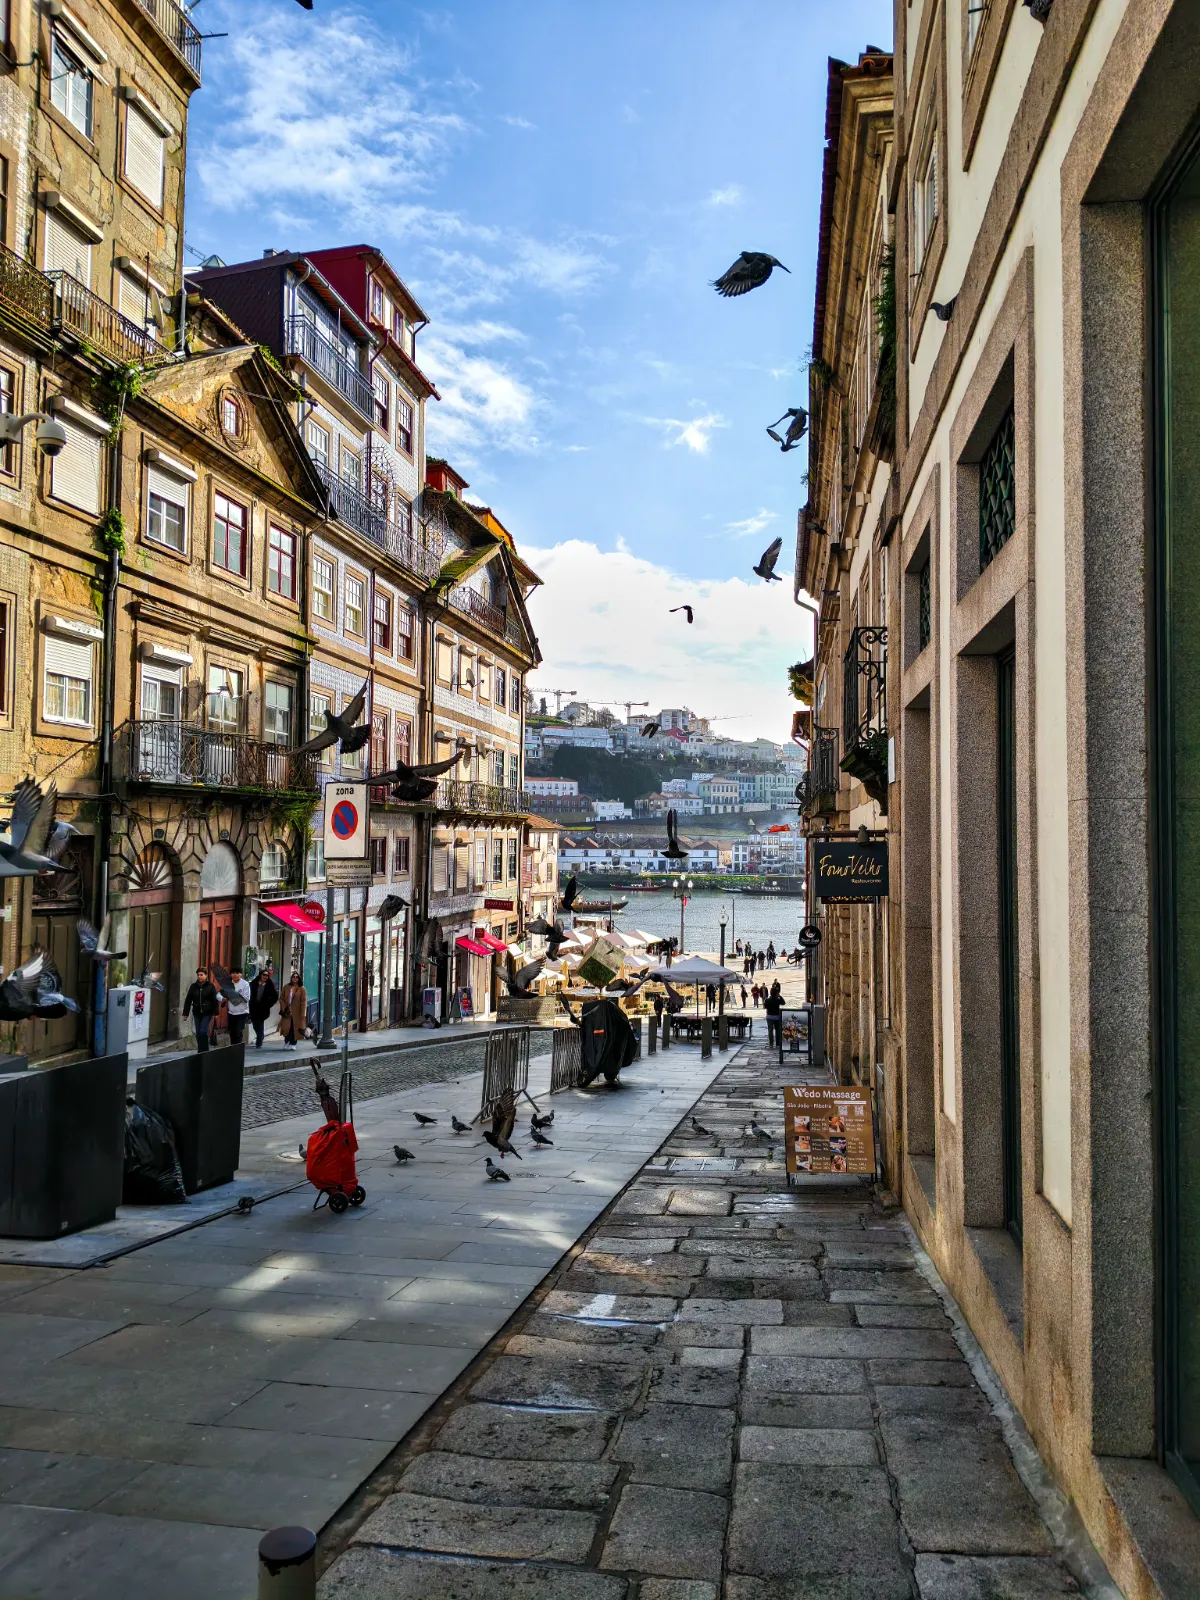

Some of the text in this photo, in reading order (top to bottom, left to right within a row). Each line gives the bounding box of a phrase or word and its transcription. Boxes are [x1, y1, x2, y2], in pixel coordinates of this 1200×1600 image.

[336, 787, 354, 795] zona
[792, 1088, 860, 1100] Wedo Massage
